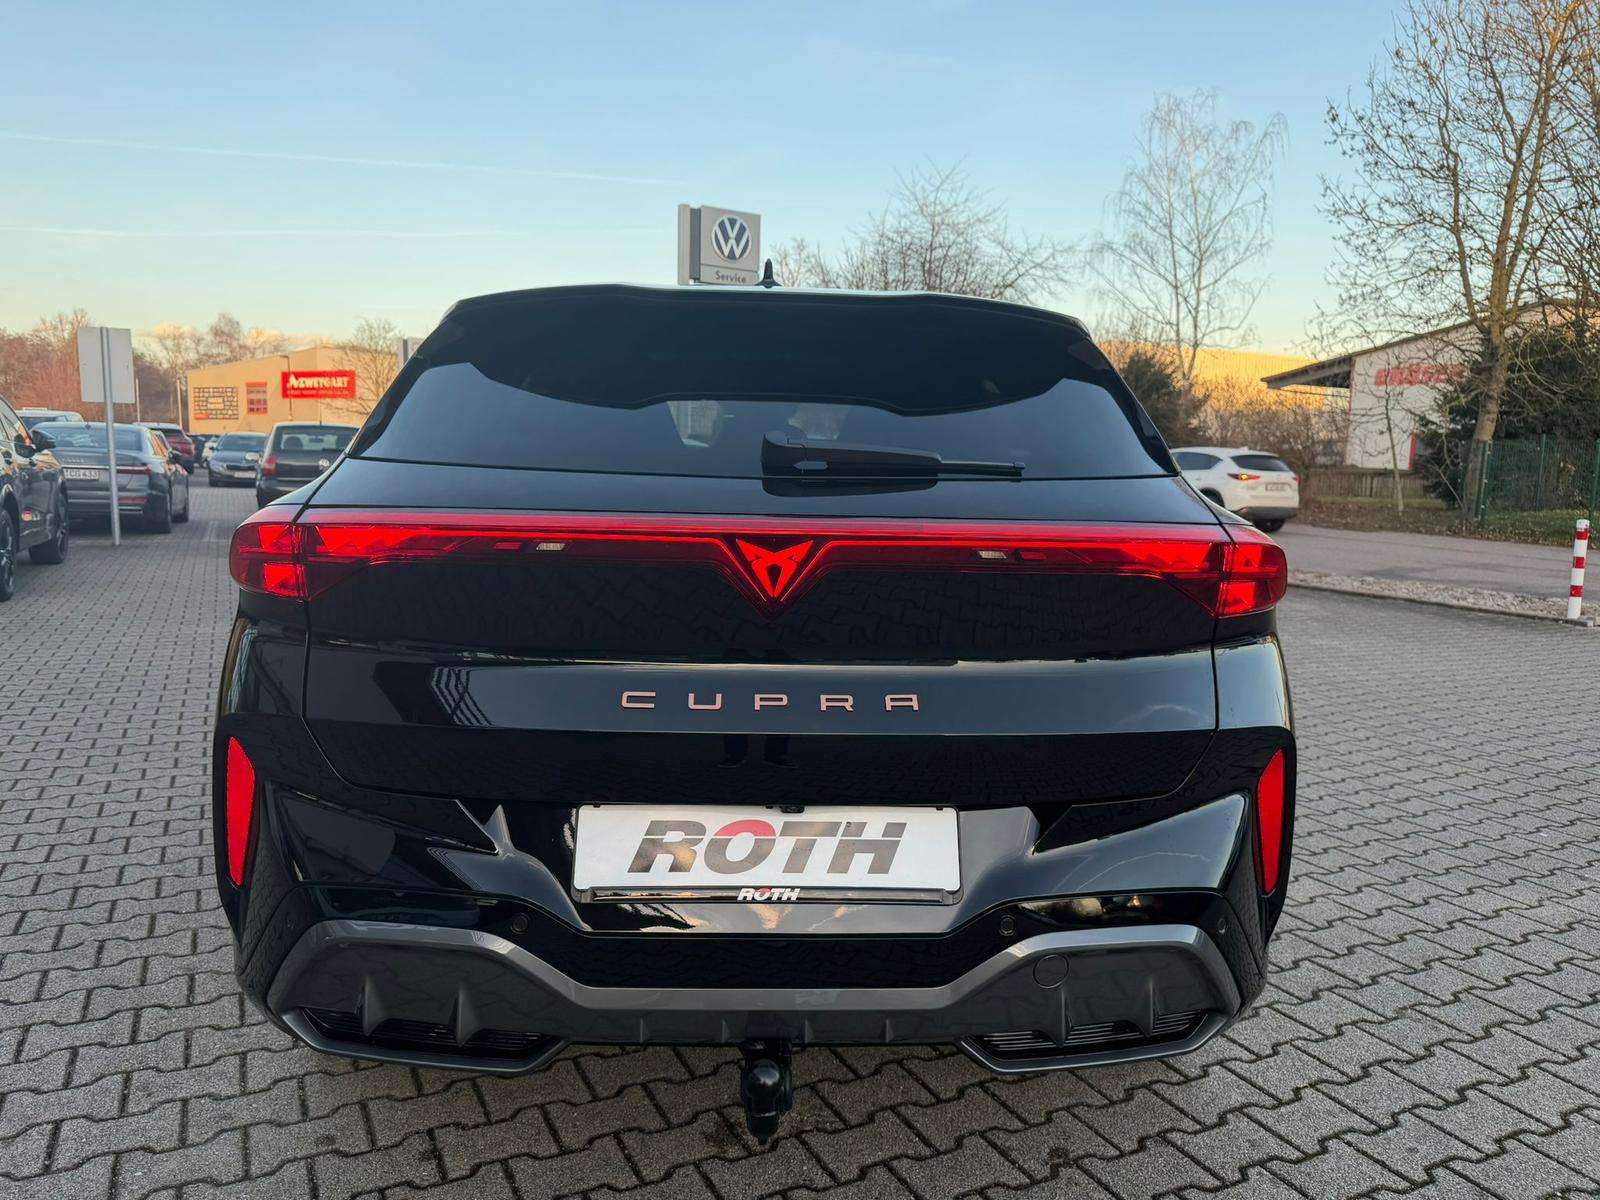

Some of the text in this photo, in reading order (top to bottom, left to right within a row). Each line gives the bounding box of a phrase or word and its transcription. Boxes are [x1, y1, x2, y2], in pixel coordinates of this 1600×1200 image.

[715, 270, 746, 283] Service
[621, 691, 919, 711] CUPRA
[627, 819, 907, 875] ROTH
[737, 887, 800, 901] ROTH
